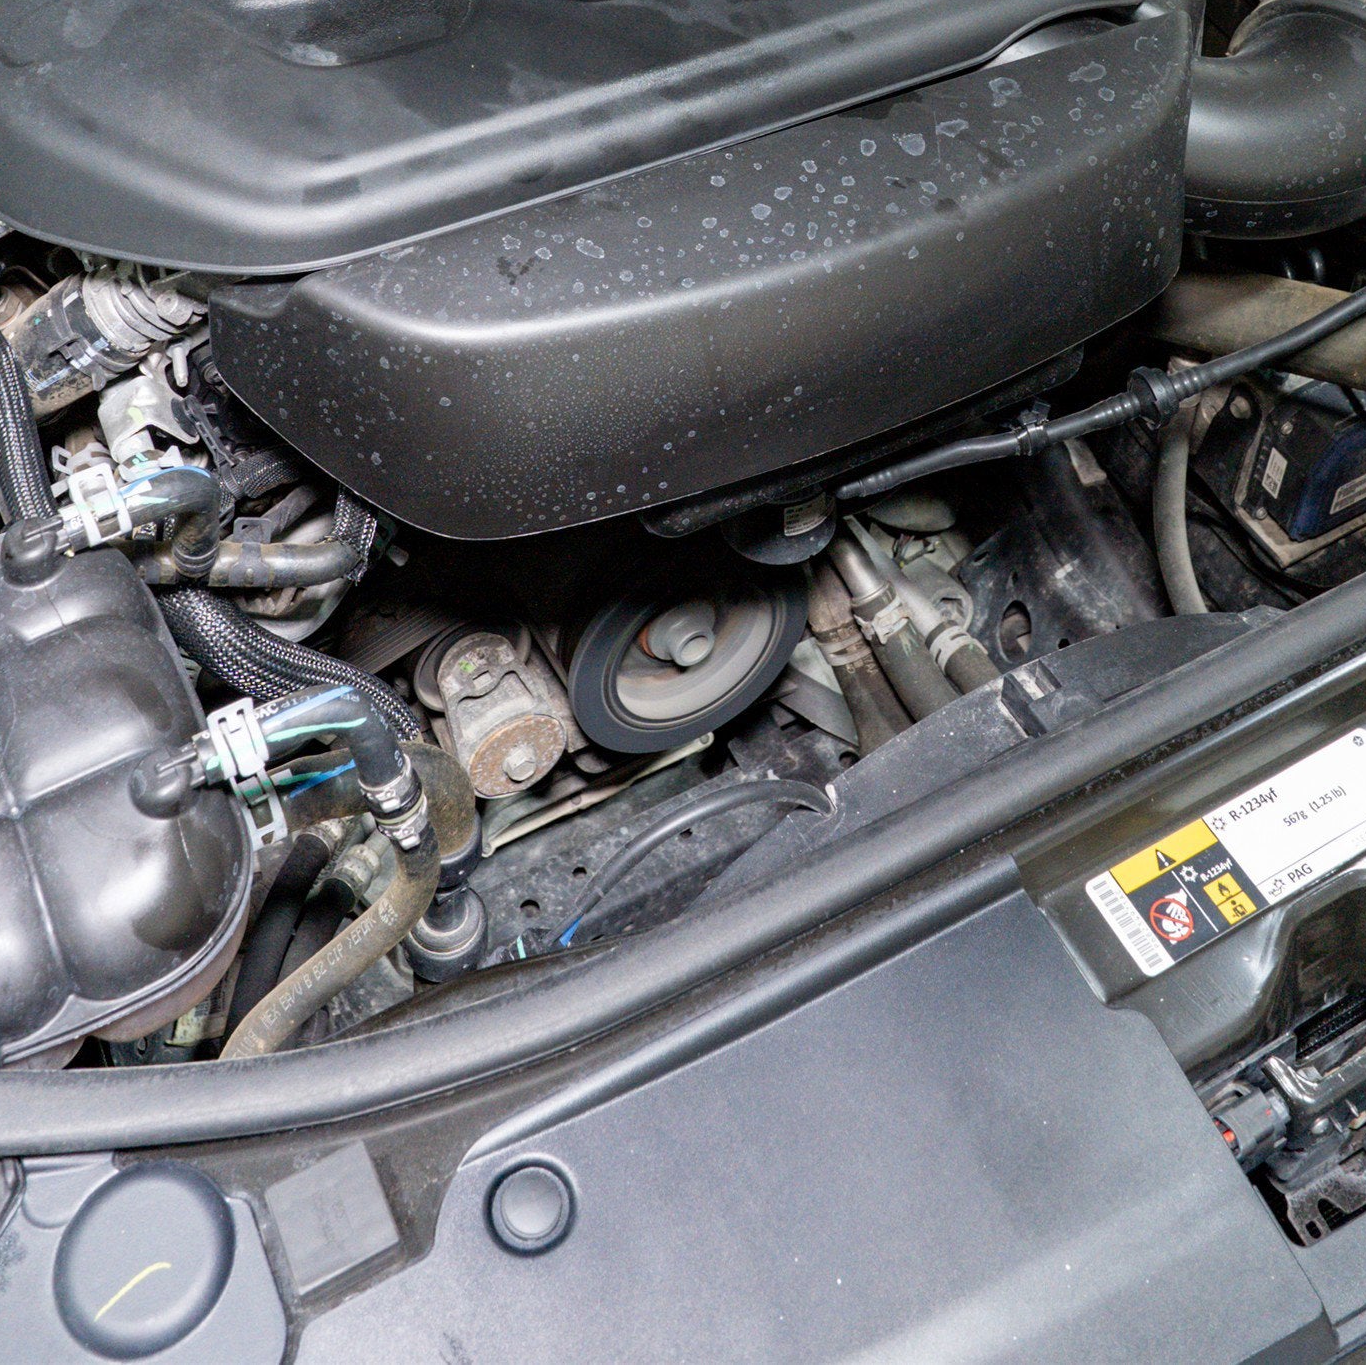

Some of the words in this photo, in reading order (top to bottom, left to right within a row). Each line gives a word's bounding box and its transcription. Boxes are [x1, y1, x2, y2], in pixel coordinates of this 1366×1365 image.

[1228, 785, 1278, 821] R-1234yf
[1282, 808, 1309, 827] 567g
[1307, 792, 1334, 814] (1.25
[1330, 784, 1347, 799] lb)
[1199, 857, 1234, 883] R-1234yf
[1287, 861, 1313, 884] PAG
[324, 942, 347, 967] CIP
